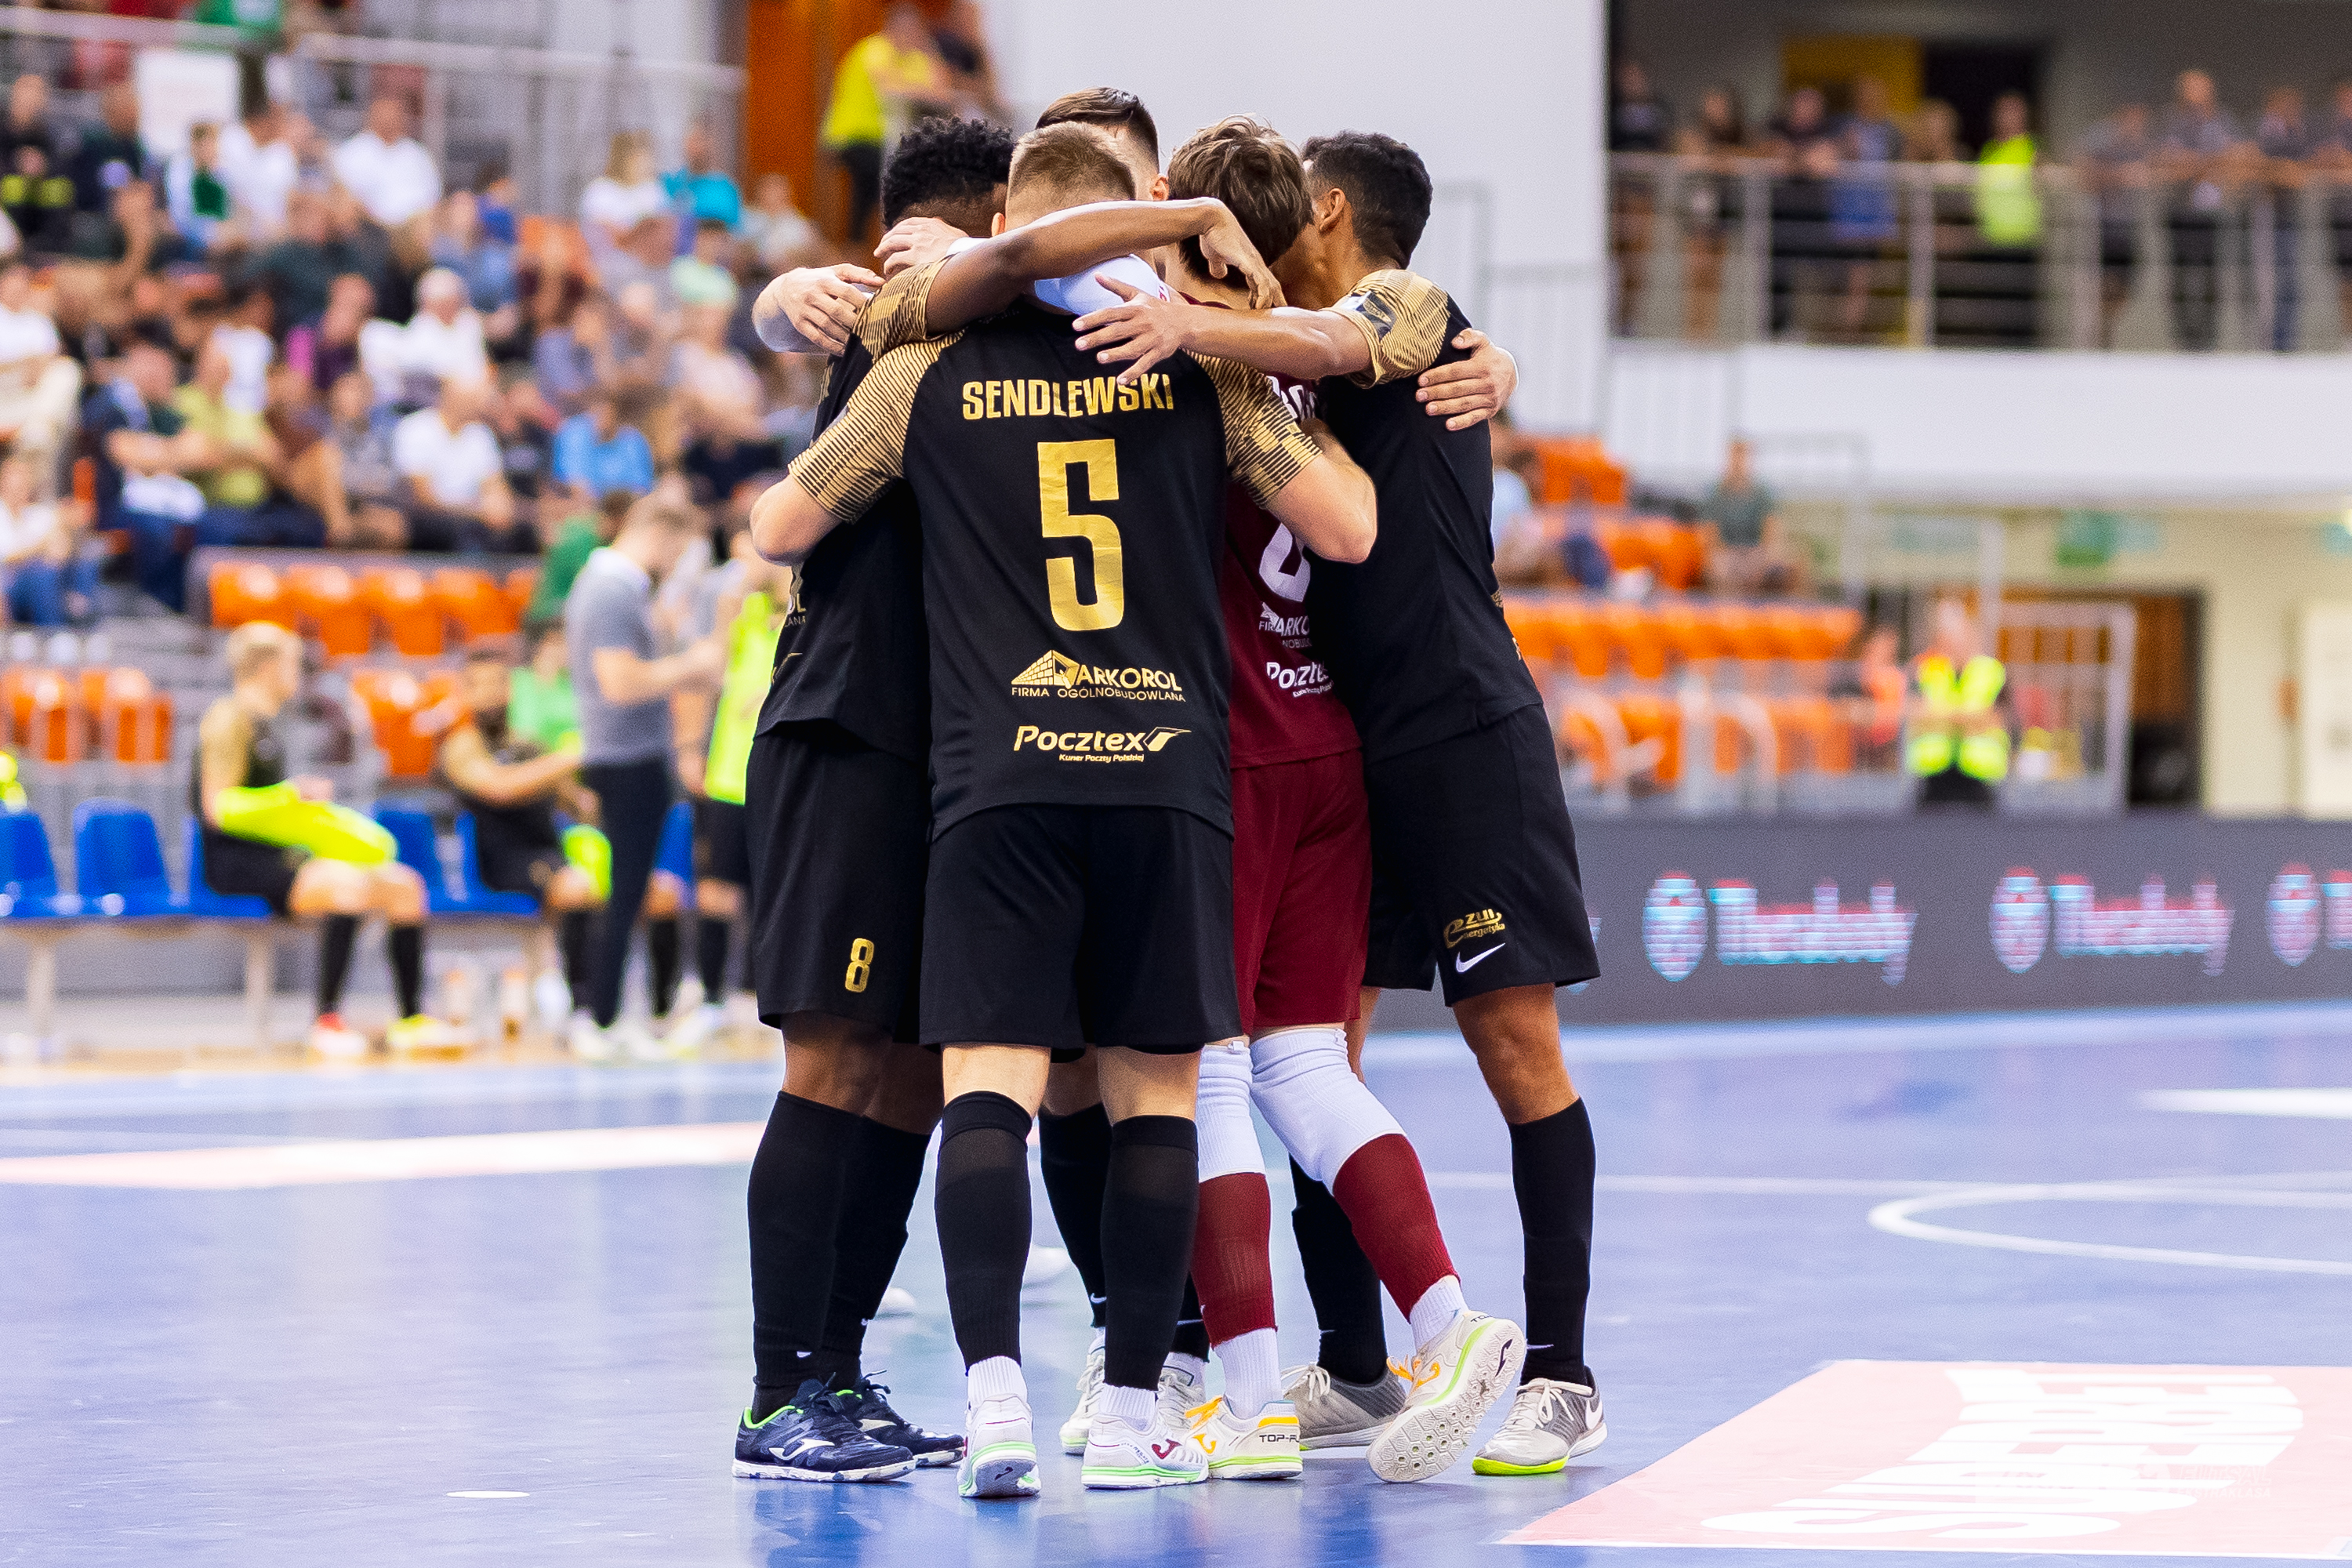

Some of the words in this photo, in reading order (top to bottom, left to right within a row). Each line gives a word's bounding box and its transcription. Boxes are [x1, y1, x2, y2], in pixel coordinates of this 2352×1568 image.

[962, 373, 1174, 420] SENDLEWSKI
[1037, 438, 1125, 632] 5
[1011, 687, 1050, 697] FIRMA
[1057, 686, 1186, 702] OGÓLNOBUDOWLANA
[1076, 664, 1183, 691] ARKOROL
[1014, 725, 1147, 752] Pocztex
[845, 938, 874, 993] 8
[1700, 1369, 2303, 1539] SUPERBET
